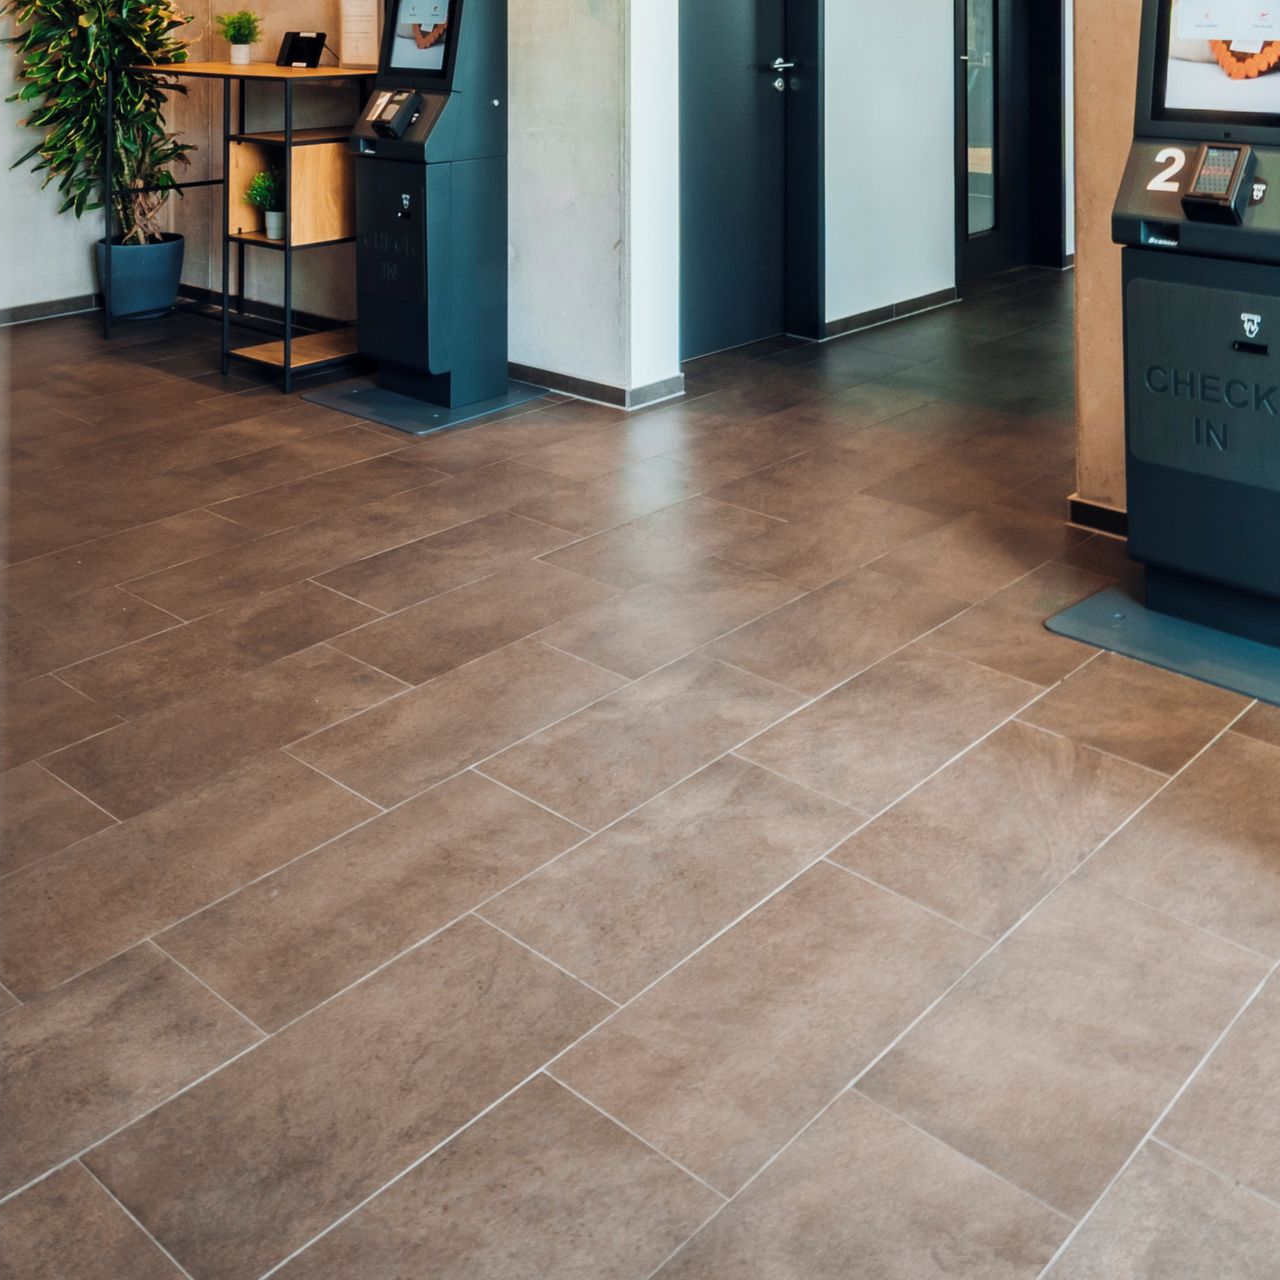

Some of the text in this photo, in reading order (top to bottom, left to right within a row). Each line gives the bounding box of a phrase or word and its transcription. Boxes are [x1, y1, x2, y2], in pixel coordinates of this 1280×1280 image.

[1146, 147, 1186, 192] 2
[1145, 365, 1279, 416] CHECK
[1193, 416, 1228, 452] IN
